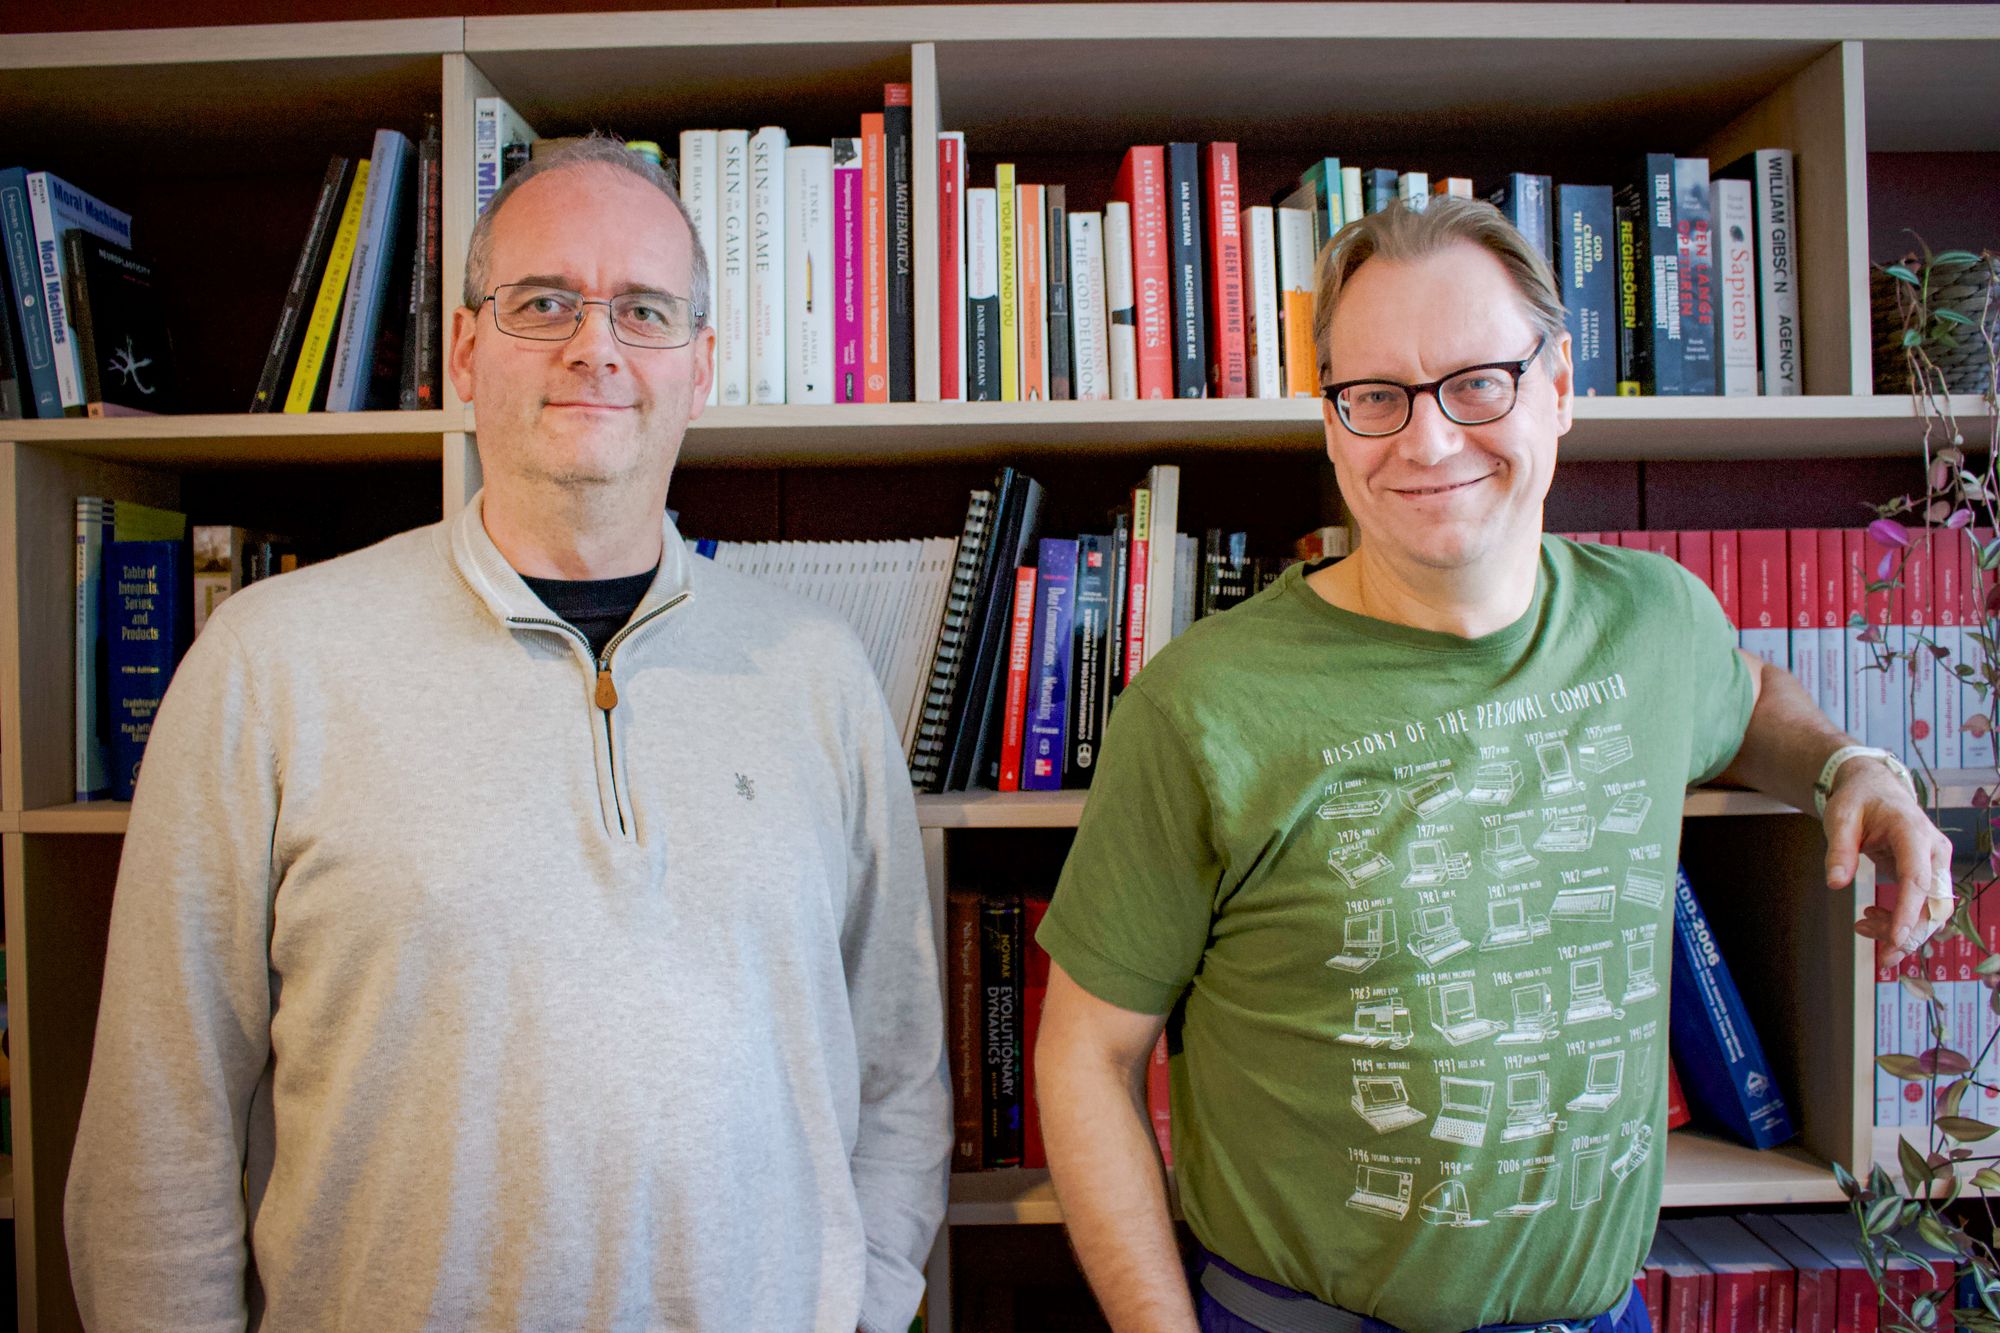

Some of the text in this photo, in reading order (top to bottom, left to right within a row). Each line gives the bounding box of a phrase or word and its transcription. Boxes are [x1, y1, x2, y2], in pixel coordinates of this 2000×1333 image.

[480, 110, 494, 118] THE
[693, 137, 703, 202] THE BLACK
[725, 144, 740, 195] SKIN
[754, 141, 769, 190] SKIN
[1768, 156, 1785, 223] WILLIAM
[53, 182, 129, 238] Moral Machines
[1143, 160, 1157, 258] EIGHT YEARS
[1181, 181, 1193, 246] IAN McEWAN
[1220, 153, 1238, 237] JOHN LE CARRÉ
[1655, 173, 1672, 228] TERJE TVEDT
[7, 193, 31, 288] Human Compatible
[725, 216, 740, 278] GAME
[755, 211, 769, 273] GAME
[895, 181, 908, 275] MATHEMATICA
[1573, 211, 1585, 289] THE INTEGERS
[1583, 223, 1593, 273] CREATED
[1593, 235, 1603, 262] GOD
[1695, 220, 1709, 258] DEN
[98, 247, 151, 274] NEUROPLASTICITY
[1001, 200, 1013, 327] YOUR BRAIN AND YOU
[1621, 220, 1638, 330] REGISSÖREN
[1677, 220, 1694, 317] OPPTUREN
[40, 240, 66, 344] Moral Machines
[1075, 236, 1094, 397] THE GOD DELUSION
[1143, 277, 1159, 349] COATES
[1183, 264, 1197, 361] MACHINES LIKE ME
[1225, 244, 1243, 384] AGENT RUNNING FIELD
[1261, 239, 1274, 385] VONNEGUT HOCUS POCUS
[1696, 264, 1712, 325] LANGE
[1725, 248, 1751, 341] Sapiens
[810, 329, 819, 366] DANIEL
[976, 304, 986, 386] DANIEL GOLEMAN
[1580, 308, 1590, 361] HAWKING
[1590, 310, 1599, 359] STEPHEN
[1778, 314, 1794, 383] AGENCY
[119, 580, 160, 595] Integrals,
[123, 564, 157, 579] Table of
[125, 596, 155, 610] Series,
[131, 611, 149, 625] and
[1130, 583, 1145, 639] COMPUTER
[122, 626, 160, 640] Products
[1036, 586, 1067, 720] Data Communications Networking
[1078, 608, 1093, 741] COMMUNICATION NETWORKS
[1323, 673, 1629, 766] HISTORY OF THE PERSONAL COMPUTER
[1524, 731, 1544, 747] 1973
[1393, 763, 1414, 781] 1971
[1479, 745, 1496, 760] 1972
[1323, 780, 1343, 797] 1971
[1602, 781, 1622, 798] 1980
[1337, 828, 1361, 844] 1976
[1416, 823, 1436, 839] 1977
[1480, 813, 1502, 829] 1977
[1417, 888, 1440, 905] 1981
[1487, 883, 1506, 900] 1981
[1560, 868, 1580, 886] 1982
[1345, 899, 1370, 915] 1980
[1676, 871, 1721, 968] KDD-2006
[1001, 934, 1011, 978] NOWAK
[1558, 944, 1577, 961] 1987
[1350, 985, 1371, 1000] 1983
[1416, 972, 1437, 988] 1984
[1492, 970, 1513, 987] 1986
[987, 986, 1001, 1065] DYNAMICS
[1000, 985, 1014, 1096] EVOLUTIONARY
[1565, 1039, 1586, 1057] 1992
[1351, 1057, 1374, 1073] 1989
[1433, 1057, 1456, 1074] 1991
[1503, 1053, 1523, 1071] 1992
[1348, 1146, 1370, 1164] 1996
[1439, 1160, 1462, 1176] 1998
[1497, 1158, 1520, 1176] 2006
[1570, 1134, 1590, 1153] 2010
